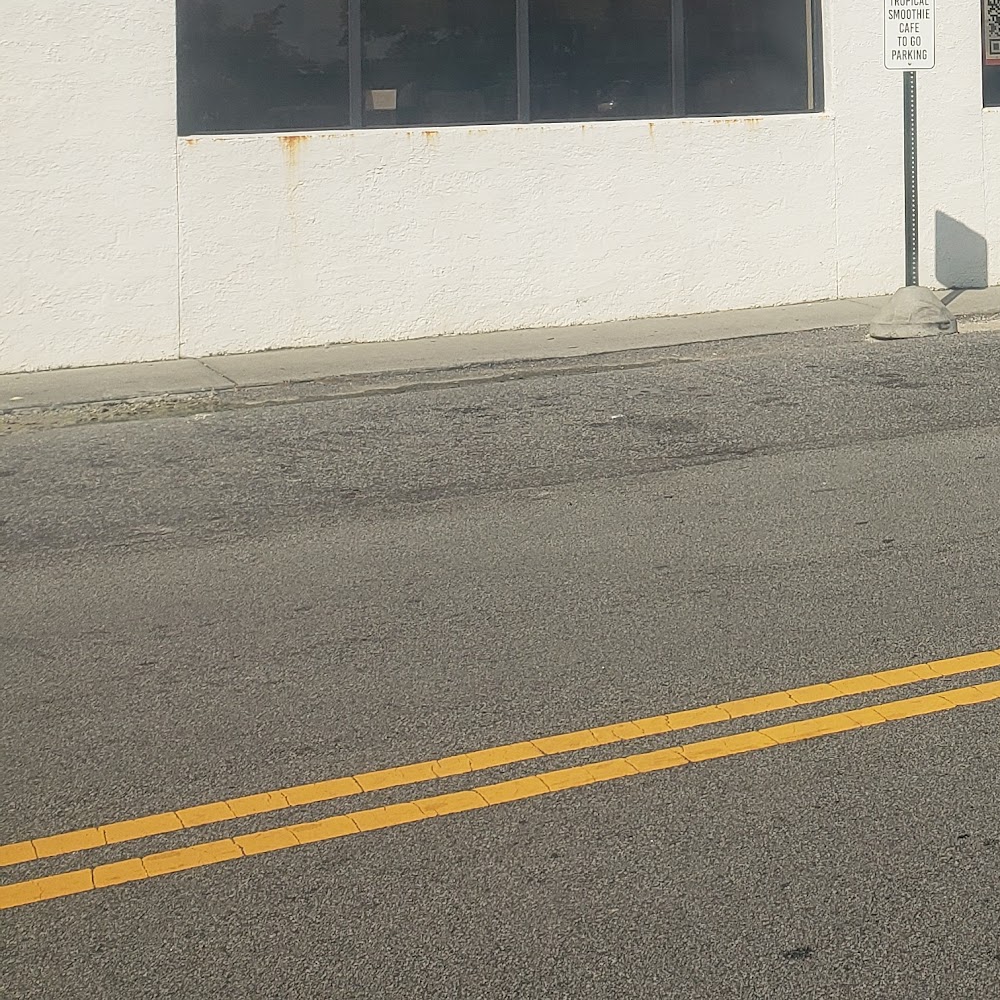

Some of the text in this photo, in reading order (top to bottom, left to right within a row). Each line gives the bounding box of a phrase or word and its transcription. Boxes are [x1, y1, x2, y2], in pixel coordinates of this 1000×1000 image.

[888, 9, 930, 20] SMOOTHIE
[899, 22, 920, 33] CAFE
[897, 36, 921, 46] TO GO
[891, 49, 928, 60] PARKING
